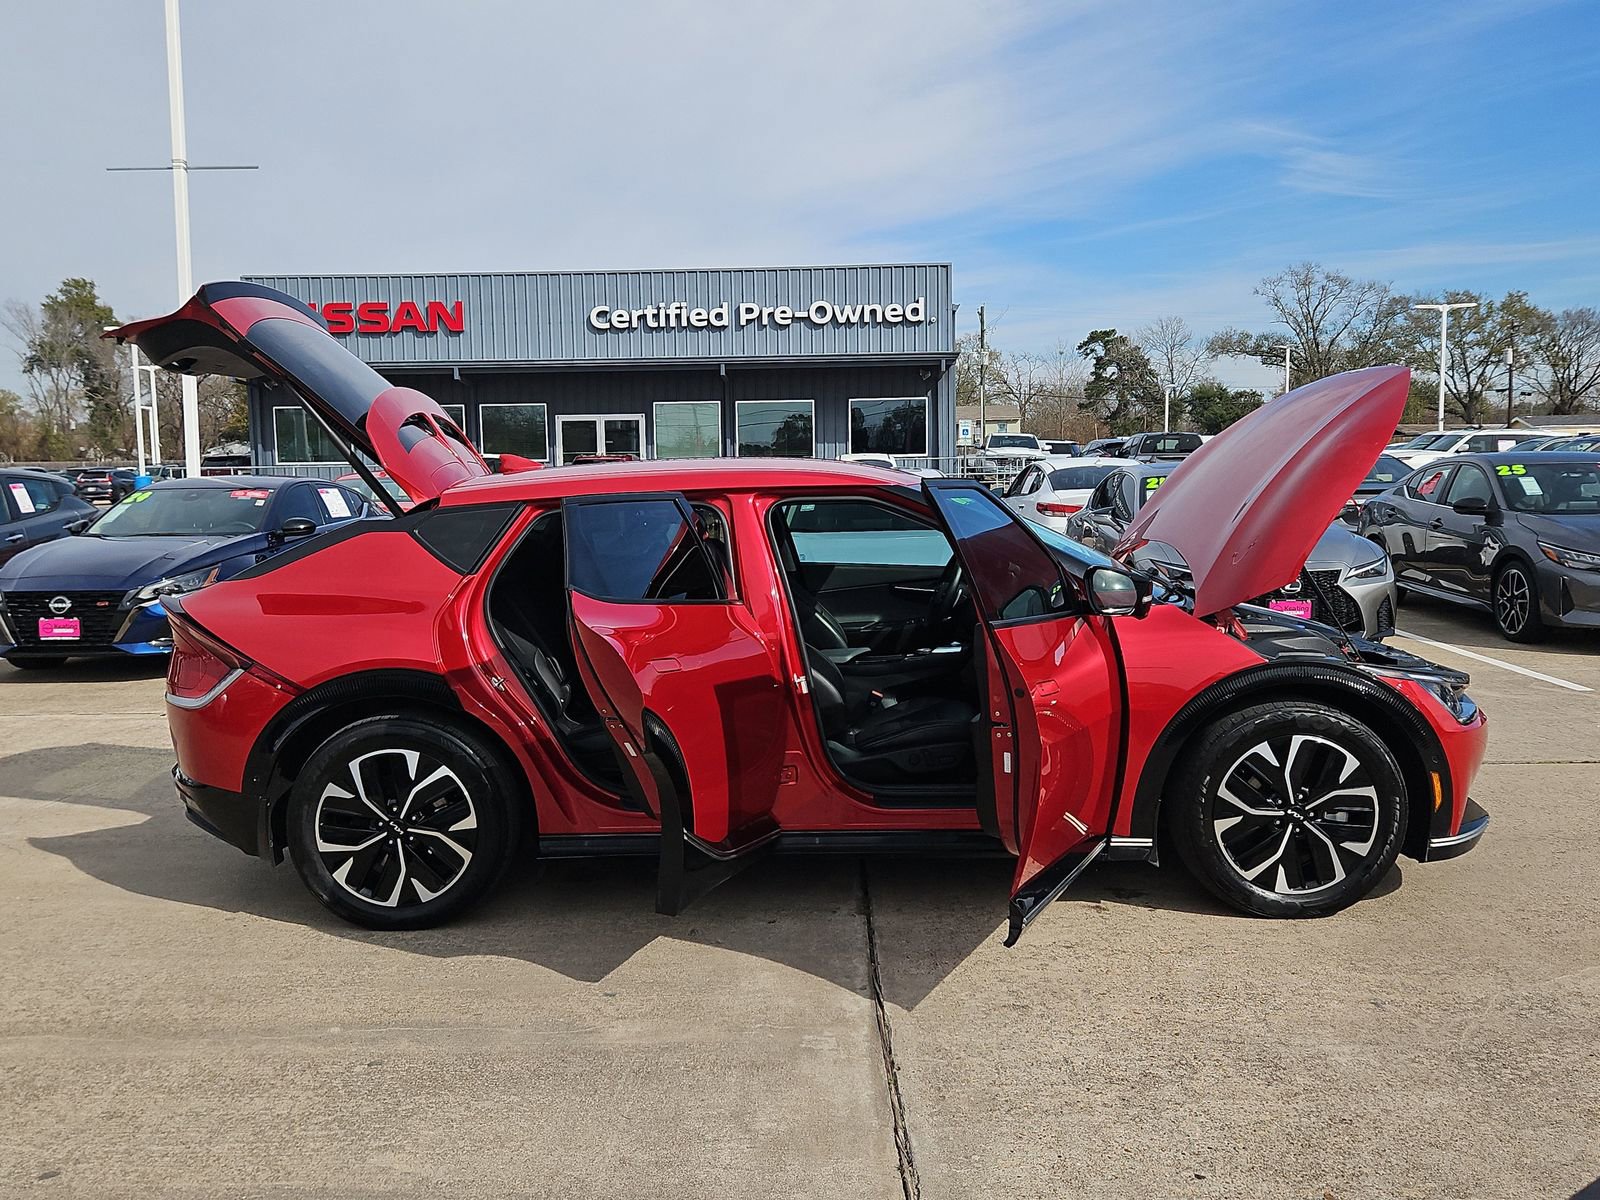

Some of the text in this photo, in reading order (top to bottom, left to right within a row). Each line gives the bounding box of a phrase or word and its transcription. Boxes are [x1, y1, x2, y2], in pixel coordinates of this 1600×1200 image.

[308, 300, 464, 333] SSAN
[589, 296, 925, 330] Certified Pre-Owned
[1496, 464, 1527, 476] 25
[1284, 605, 1309, 613] Keating
